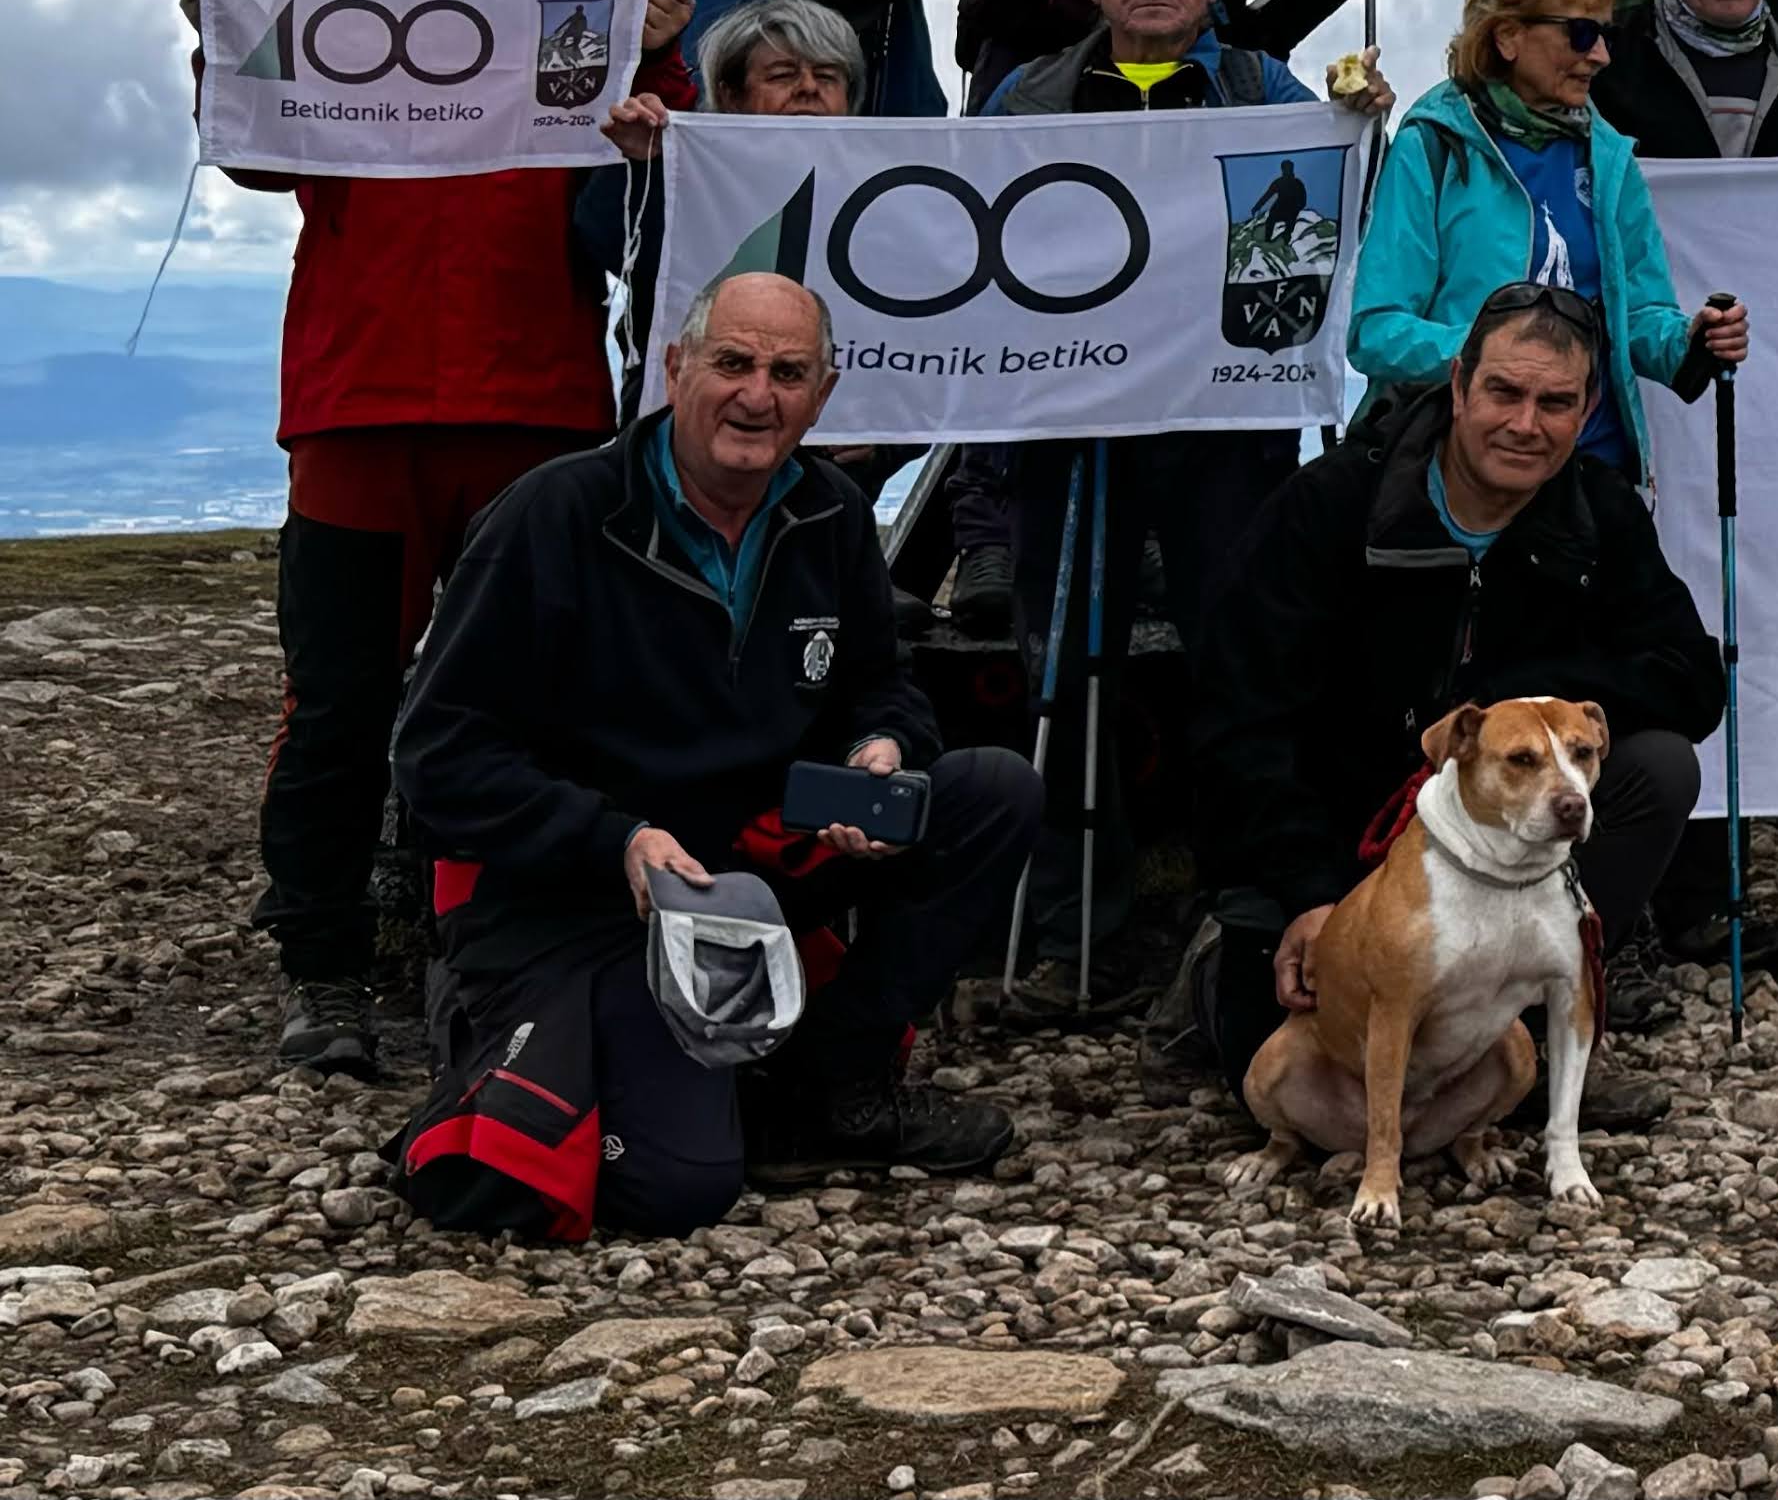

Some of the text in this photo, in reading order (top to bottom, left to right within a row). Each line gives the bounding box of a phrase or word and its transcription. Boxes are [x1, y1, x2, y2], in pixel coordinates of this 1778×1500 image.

[280, 99, 484, 122] Betidanik betiko
[776, 161, 1151, 319] 100
[1274, 281, 1288, 303] F
[1243, 302, 1261, 324] V
[1298, 296, 1317, 317] N
[1264, 317, 1281, 338] A
[829, 340, 1129, 376] tidanik betiko
